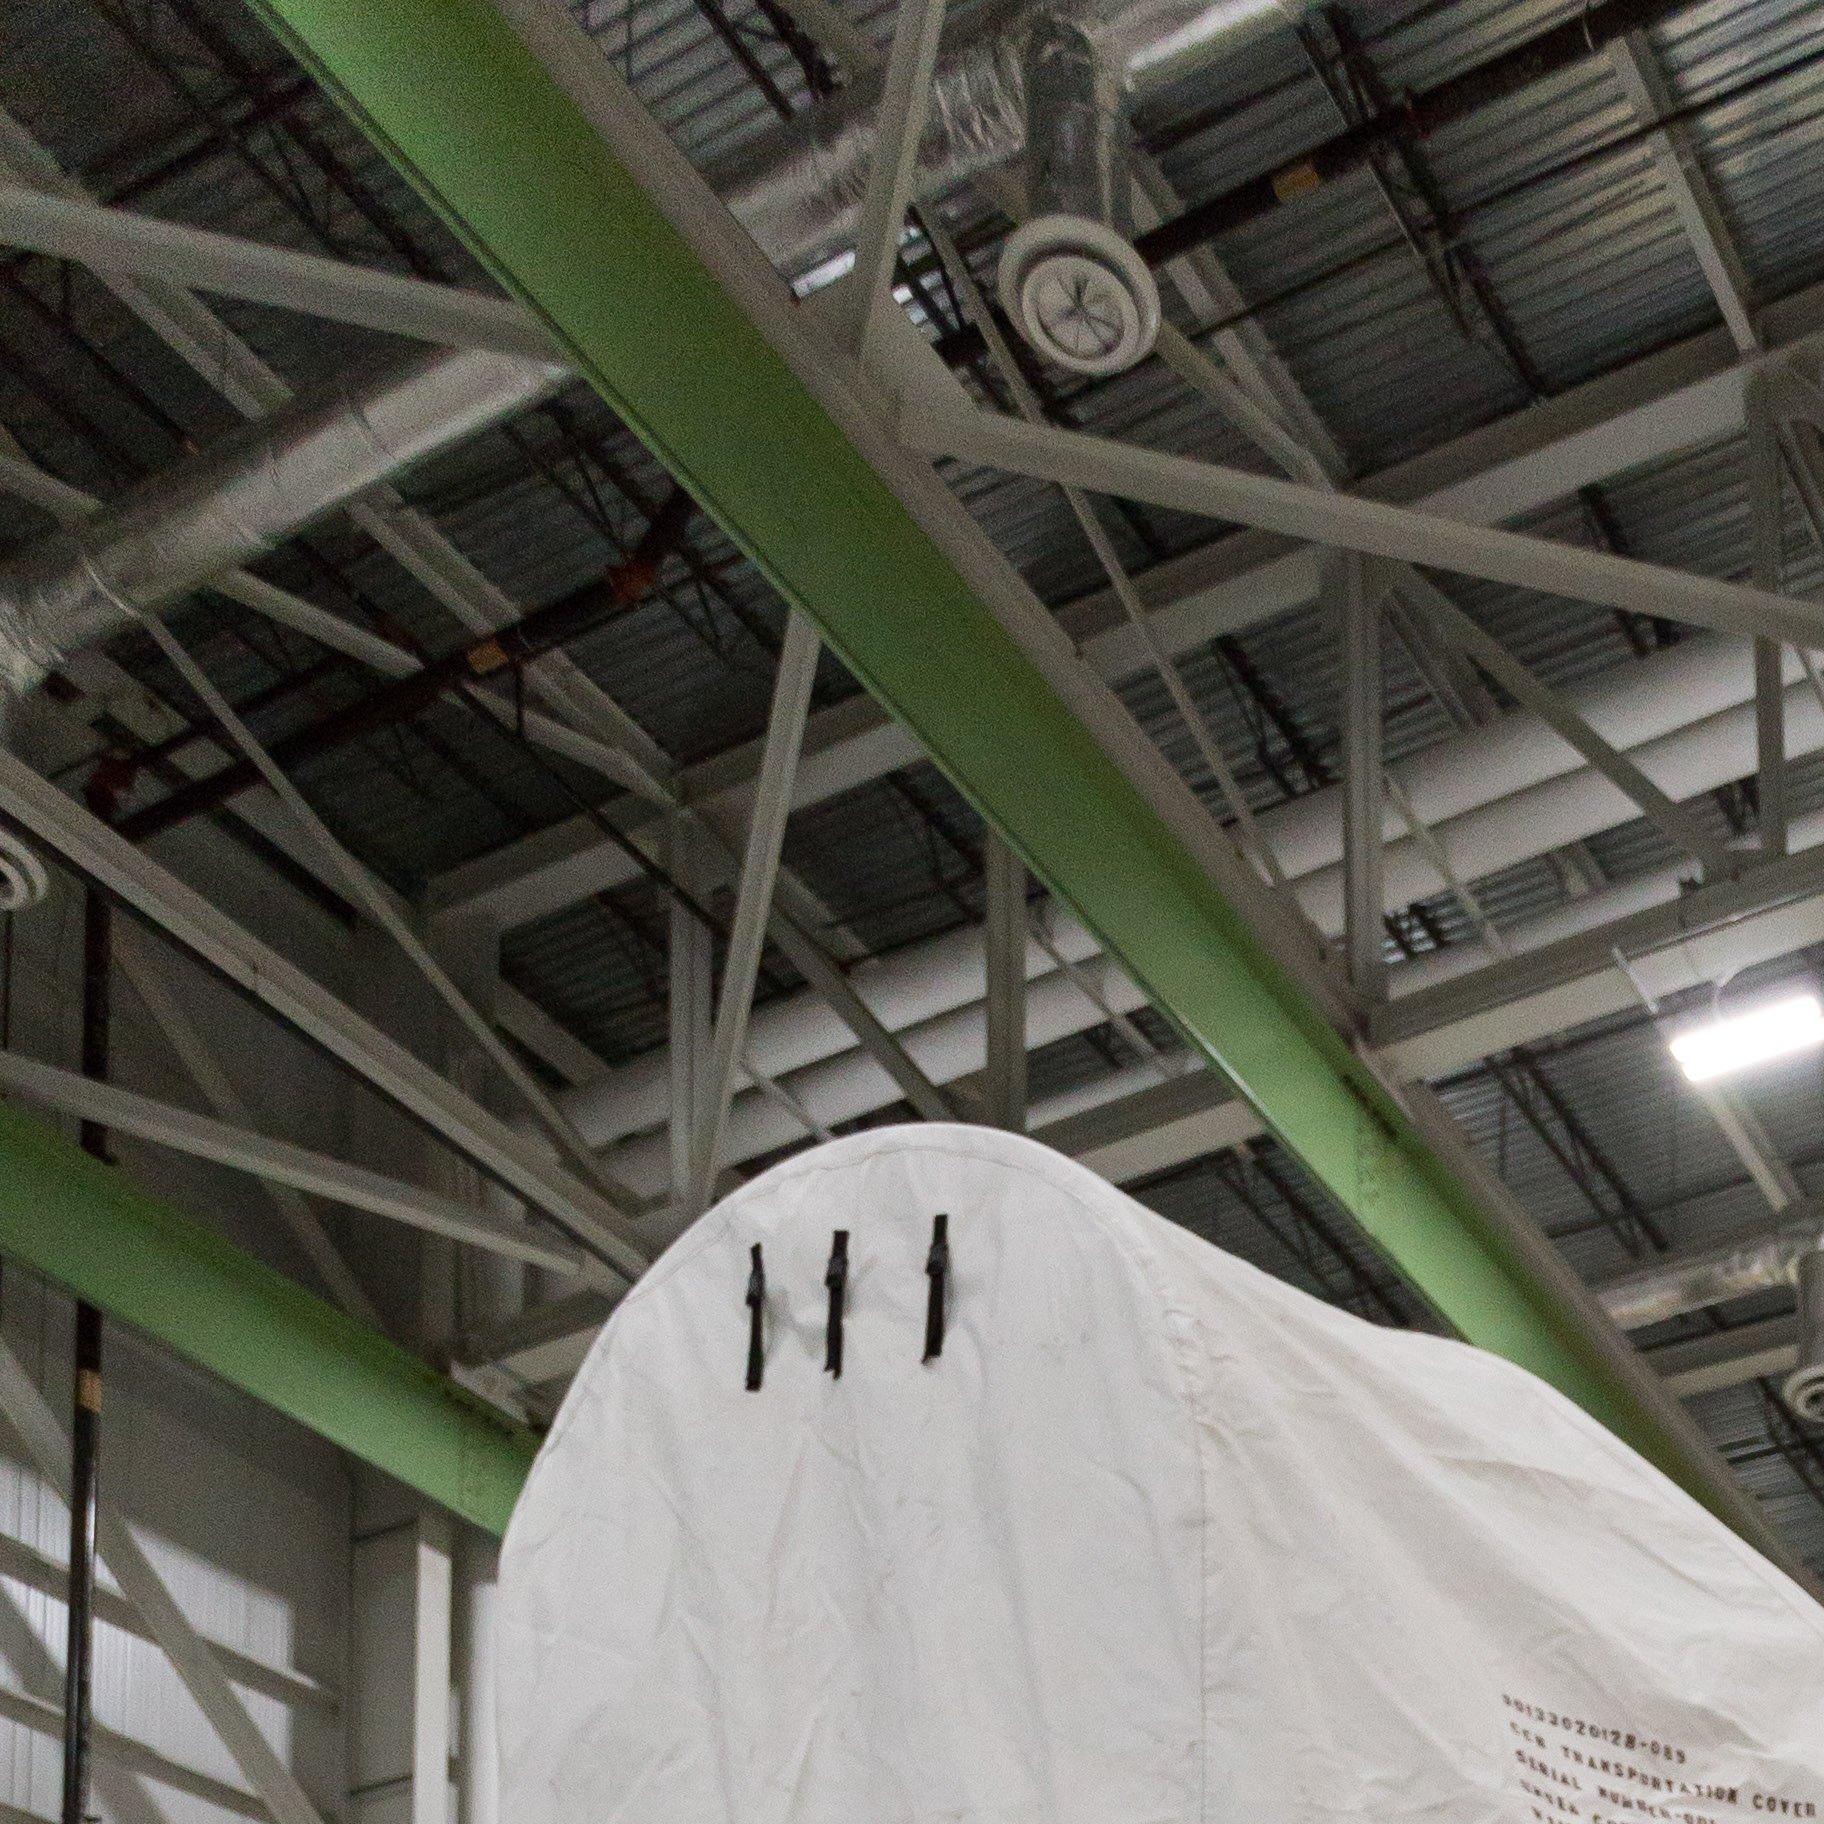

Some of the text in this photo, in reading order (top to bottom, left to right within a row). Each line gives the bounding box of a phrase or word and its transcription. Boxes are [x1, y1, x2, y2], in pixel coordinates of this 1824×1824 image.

[1515, 1749, 1583, 1791] SERIAL
[1560, 1745, 1738, 1805] TRANSPORTATION
[1752, 1791, 1817, 1819] COVER
